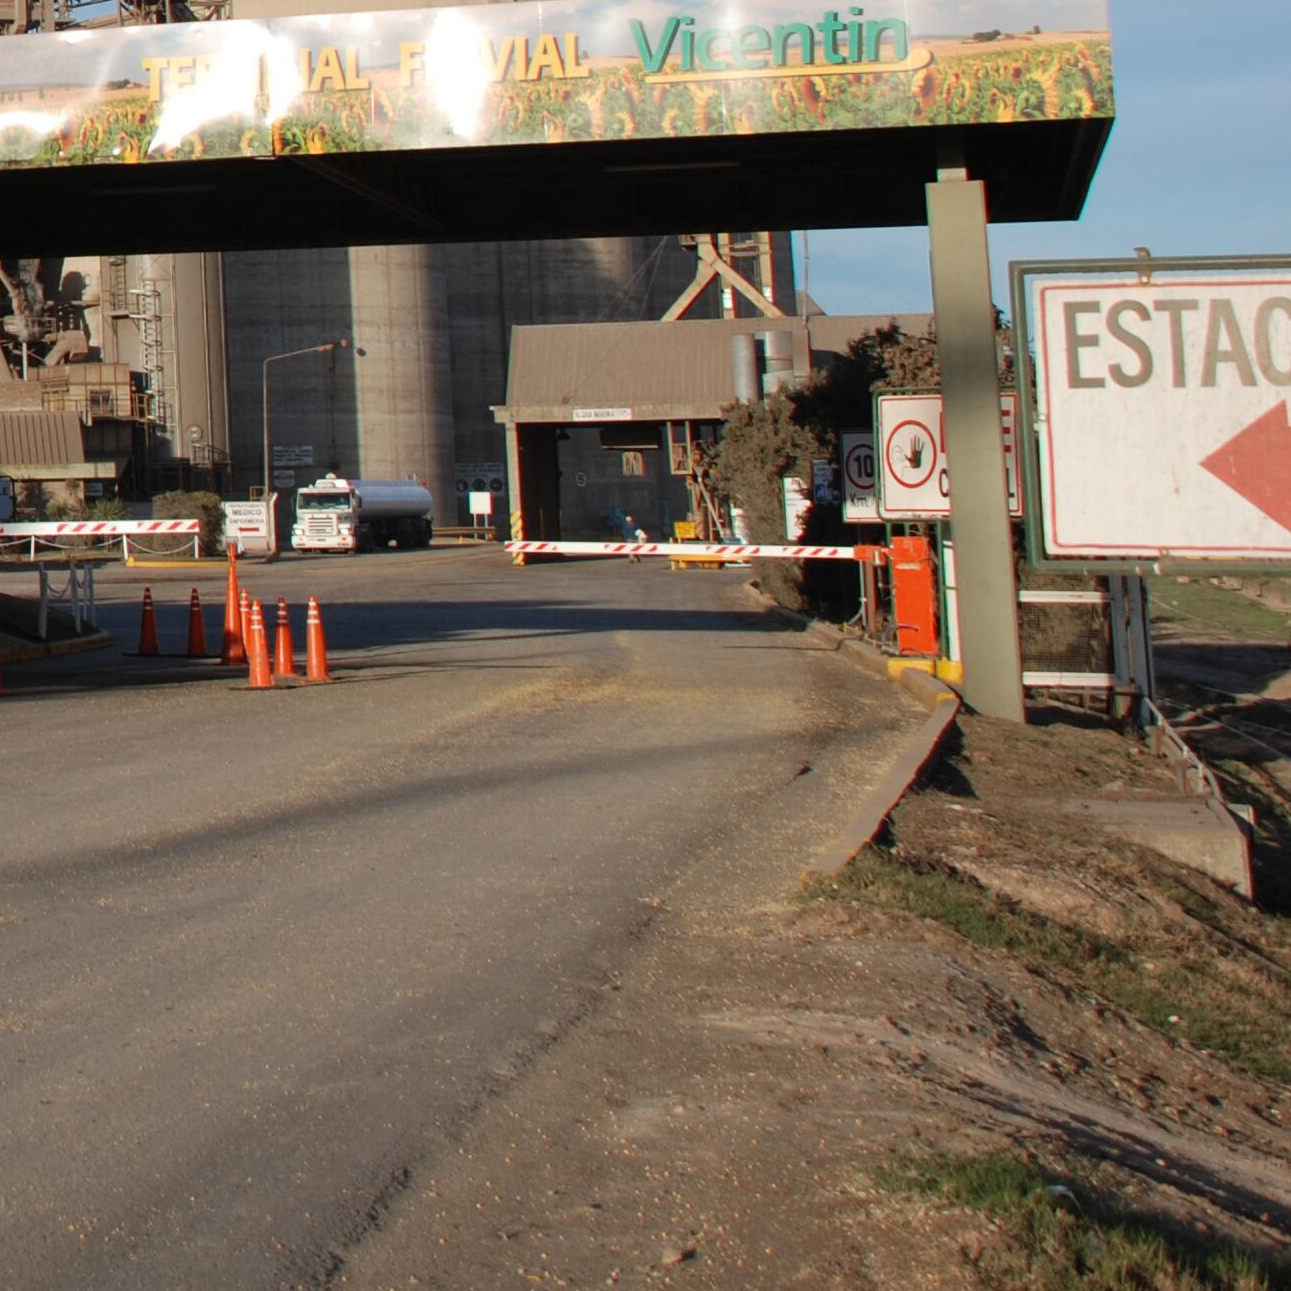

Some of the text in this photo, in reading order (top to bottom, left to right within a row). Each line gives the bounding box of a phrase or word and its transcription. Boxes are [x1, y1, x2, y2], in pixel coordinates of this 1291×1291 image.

[399, 32, 593, 87] FVIAL
[628, 6, 910, 72] Vicentin
[853, 454, 874, 478] 10
